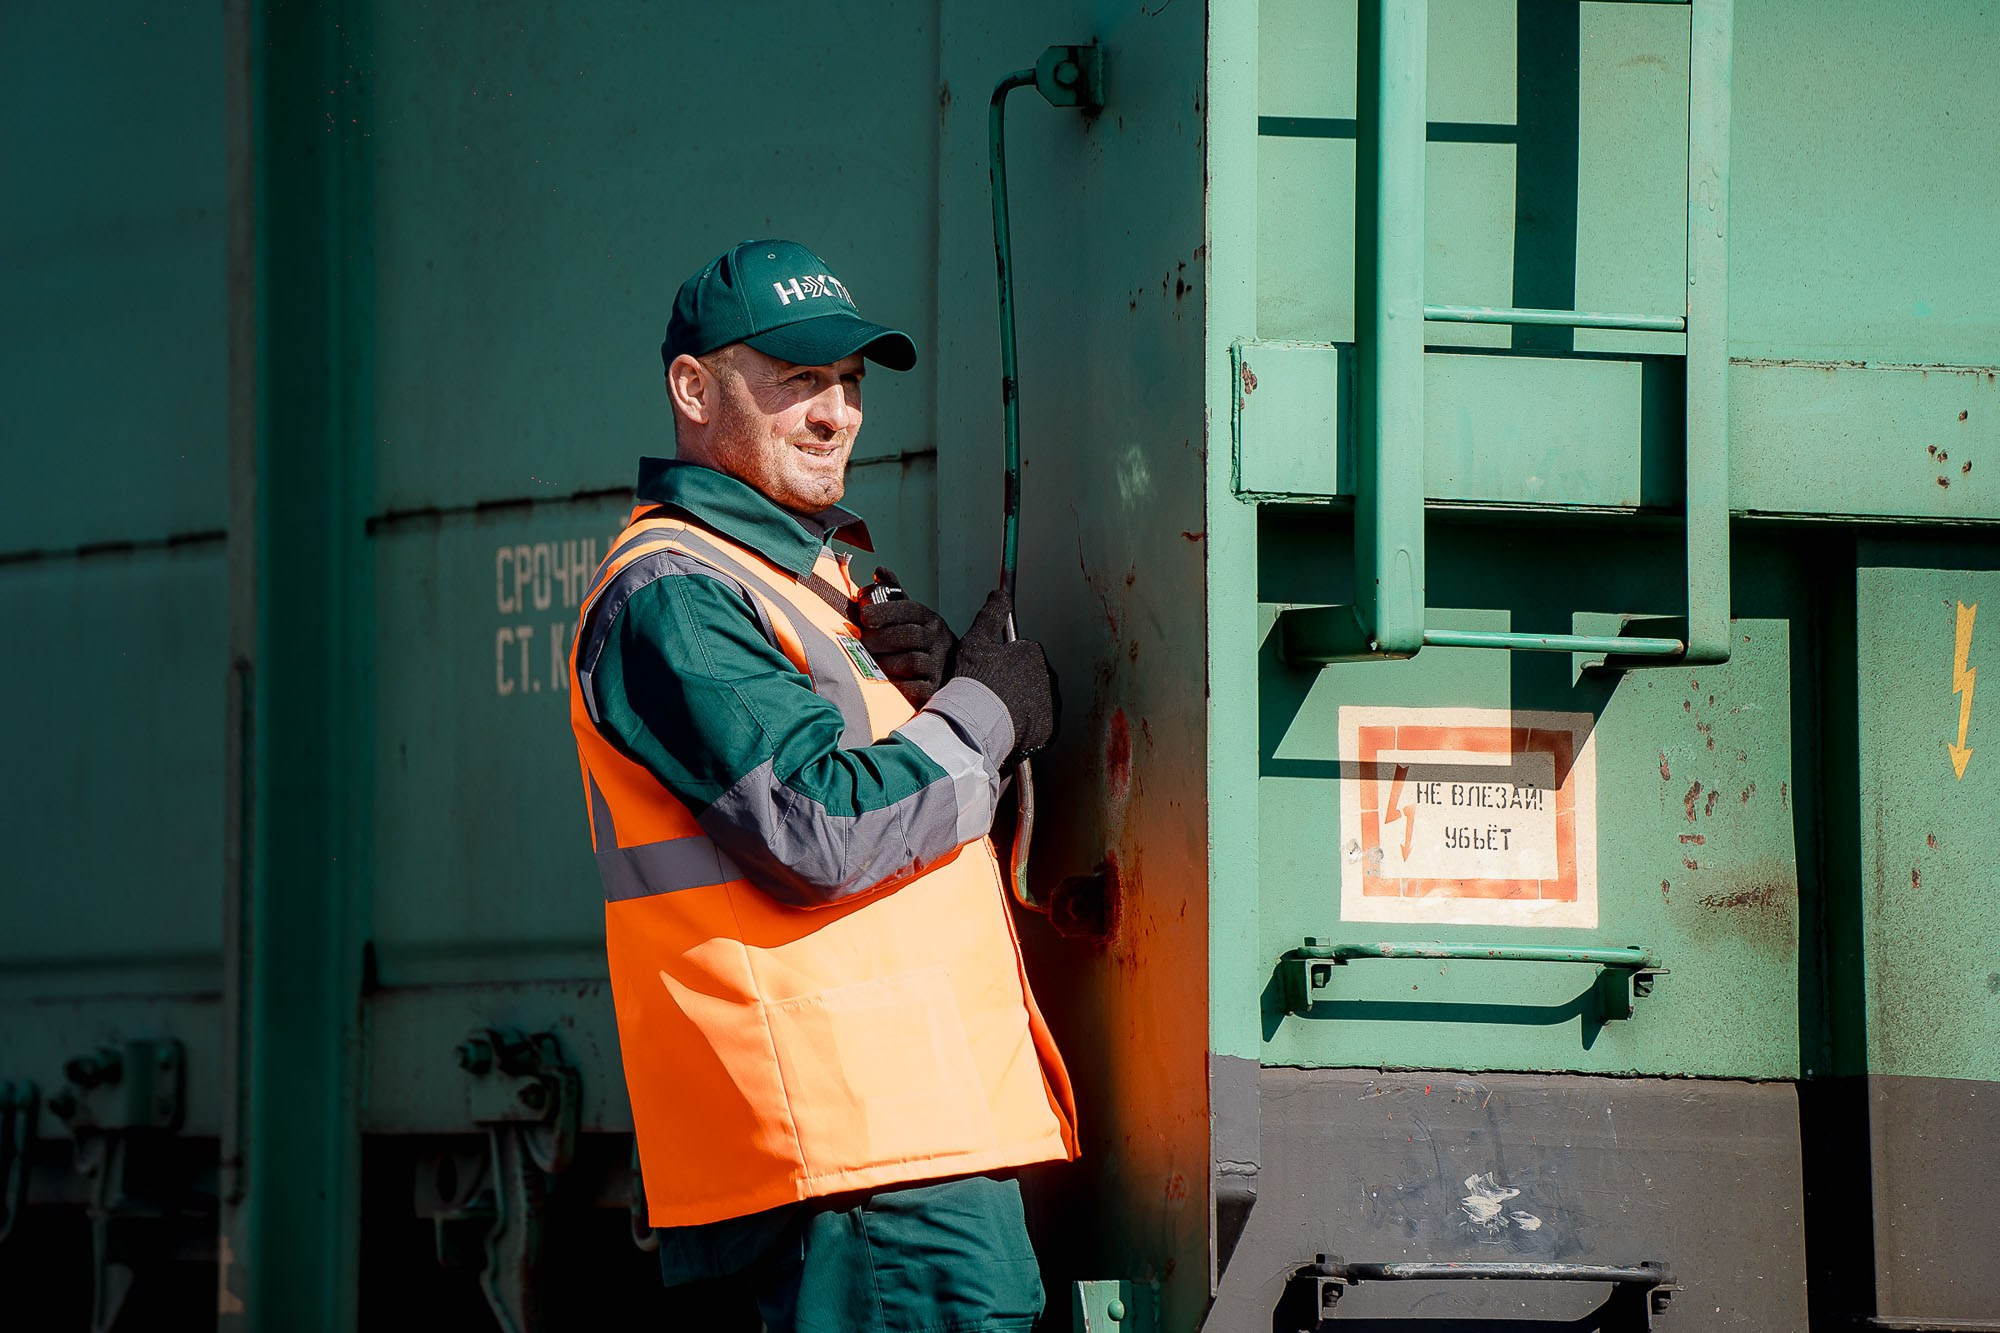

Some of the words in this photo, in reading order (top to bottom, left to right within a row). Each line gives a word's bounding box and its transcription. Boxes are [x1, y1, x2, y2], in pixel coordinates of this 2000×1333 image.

[496, 626, 540, 696] СТ.
[551, 621, 577, 690] К
[1416, 782, 1442, 805] НЕ
[1451, 783, 1543, 811] ВЛЕЗАЙ!
[1445, 823, 1512, 851] УБЬЁТ
